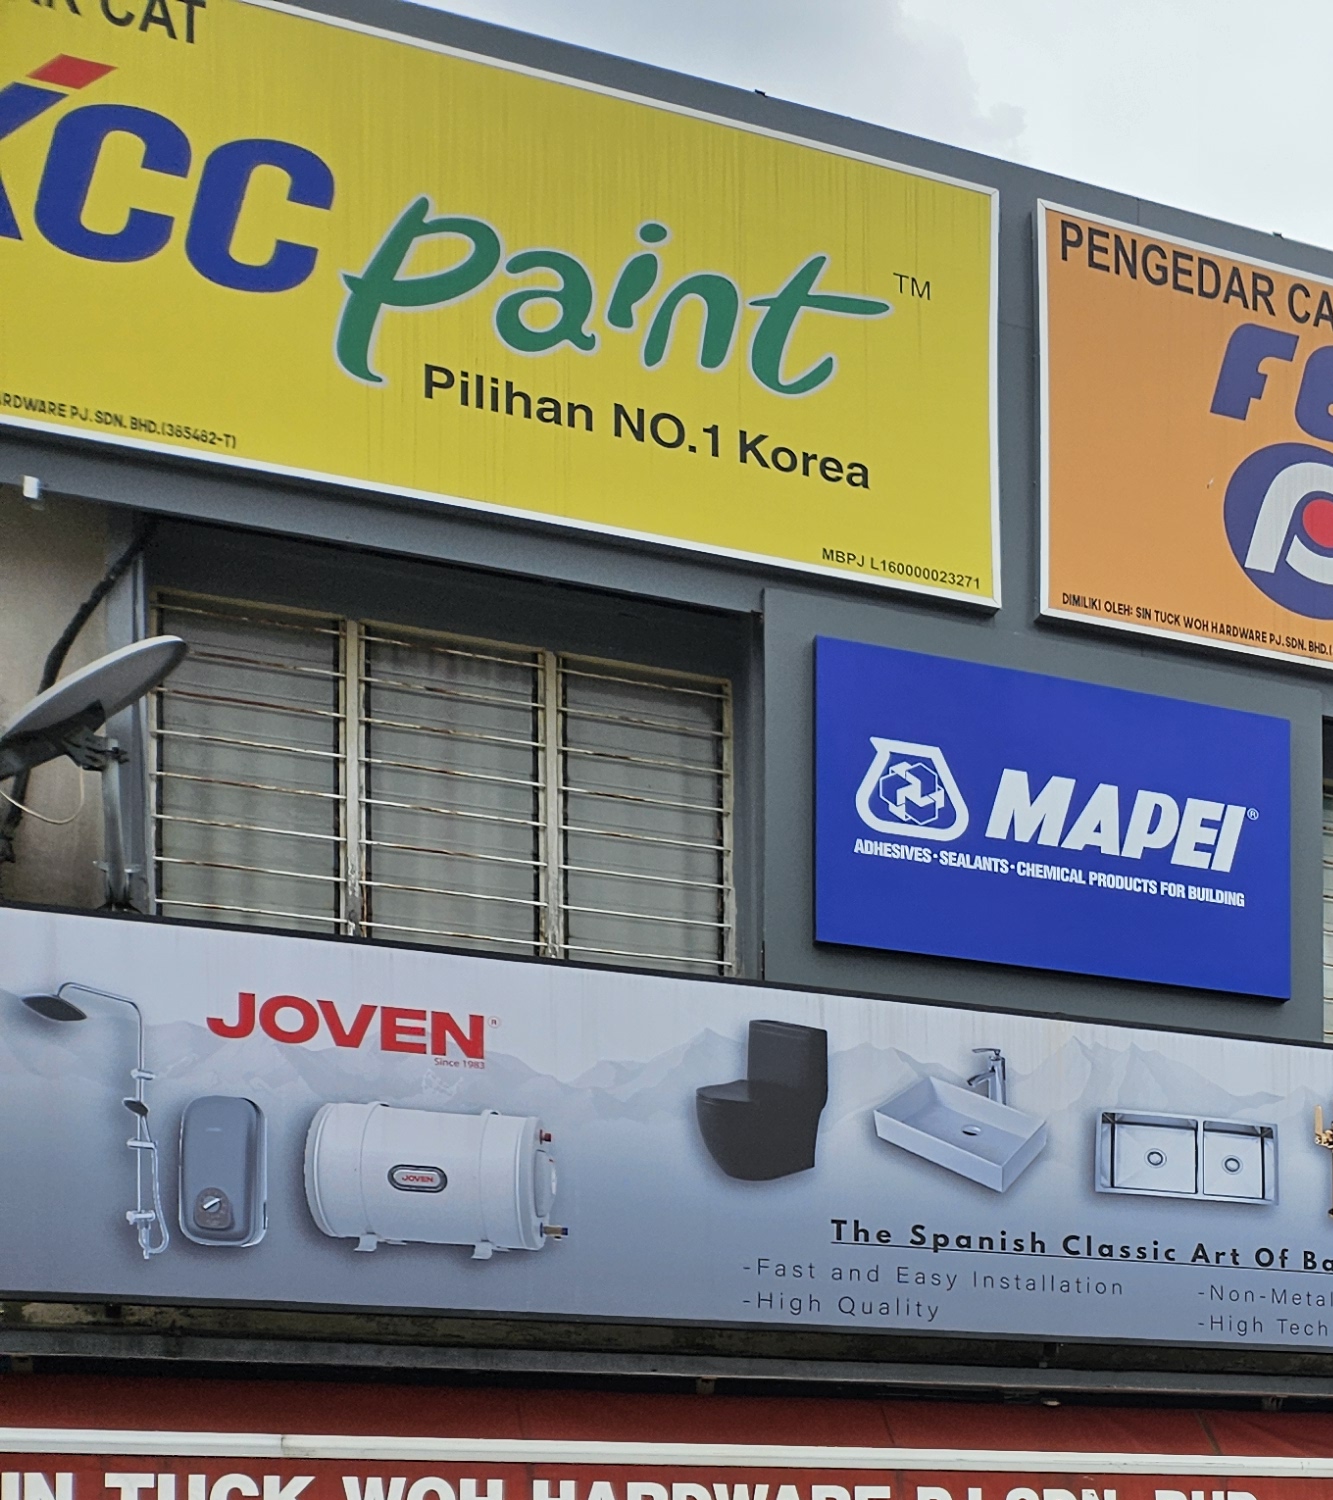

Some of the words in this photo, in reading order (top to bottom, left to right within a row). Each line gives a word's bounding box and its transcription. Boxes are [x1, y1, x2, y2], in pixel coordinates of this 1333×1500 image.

[1060, 220, 1276, 317] PENGEDAR
[335, 197, 892, 396] paint
[423, 363, 595, 432] Pilihan
[613, 404, 721, 458] NO.1
[738, 431, 871, 490] Korea
[821, 548, 864, 569] MBPJ
[1063, 593, 1101, 611] DIMILIKI
[1104, 601, 1133, 616] OLEH:
[1136, 607, 1151, 620] SIN
[1154, 610, 1181, 626] TUCK
[1183, 616, 1209, 631] WOH
[1211, 622, 1267, 643] HARDWARE
[985, 768, 1247, 873] MAPEI
[853, 838, 932, 863] ADHESIVES
[939, 850, 1009, 874] SEALANTS
[1016, 861, 1085, 885] CHEMICAL
[1089, 871, 1157, 895] PRODUCTS
[1161, 881, 1185, 898] FOR
[1187, 885, 1245, 908] BUILDING
[206, 992, 485, 1060] JOVEN
[434, 1058, 460, 1067] Since
[463, 1060, 485, 1069] 1983
[402, 1174, 434, 1183] JOVEN
[831, 1218, 894, 1244] The
[910, 1223, 1048, 1254] Spanish
[1062, 1234, 1178, 1263] Classic
[1191, 1242, 1241, 1266] Art
[1254, 1247, 1290, 1270] Of
[831, 1265, 879, 1282] and
[897, 1266, 957, 1291] Easy
[973, 1271, 1124, 1295] Installation
[838, 1296, 939, 1322] Quality
[1276, 1318, 1328, 1336] Tech
